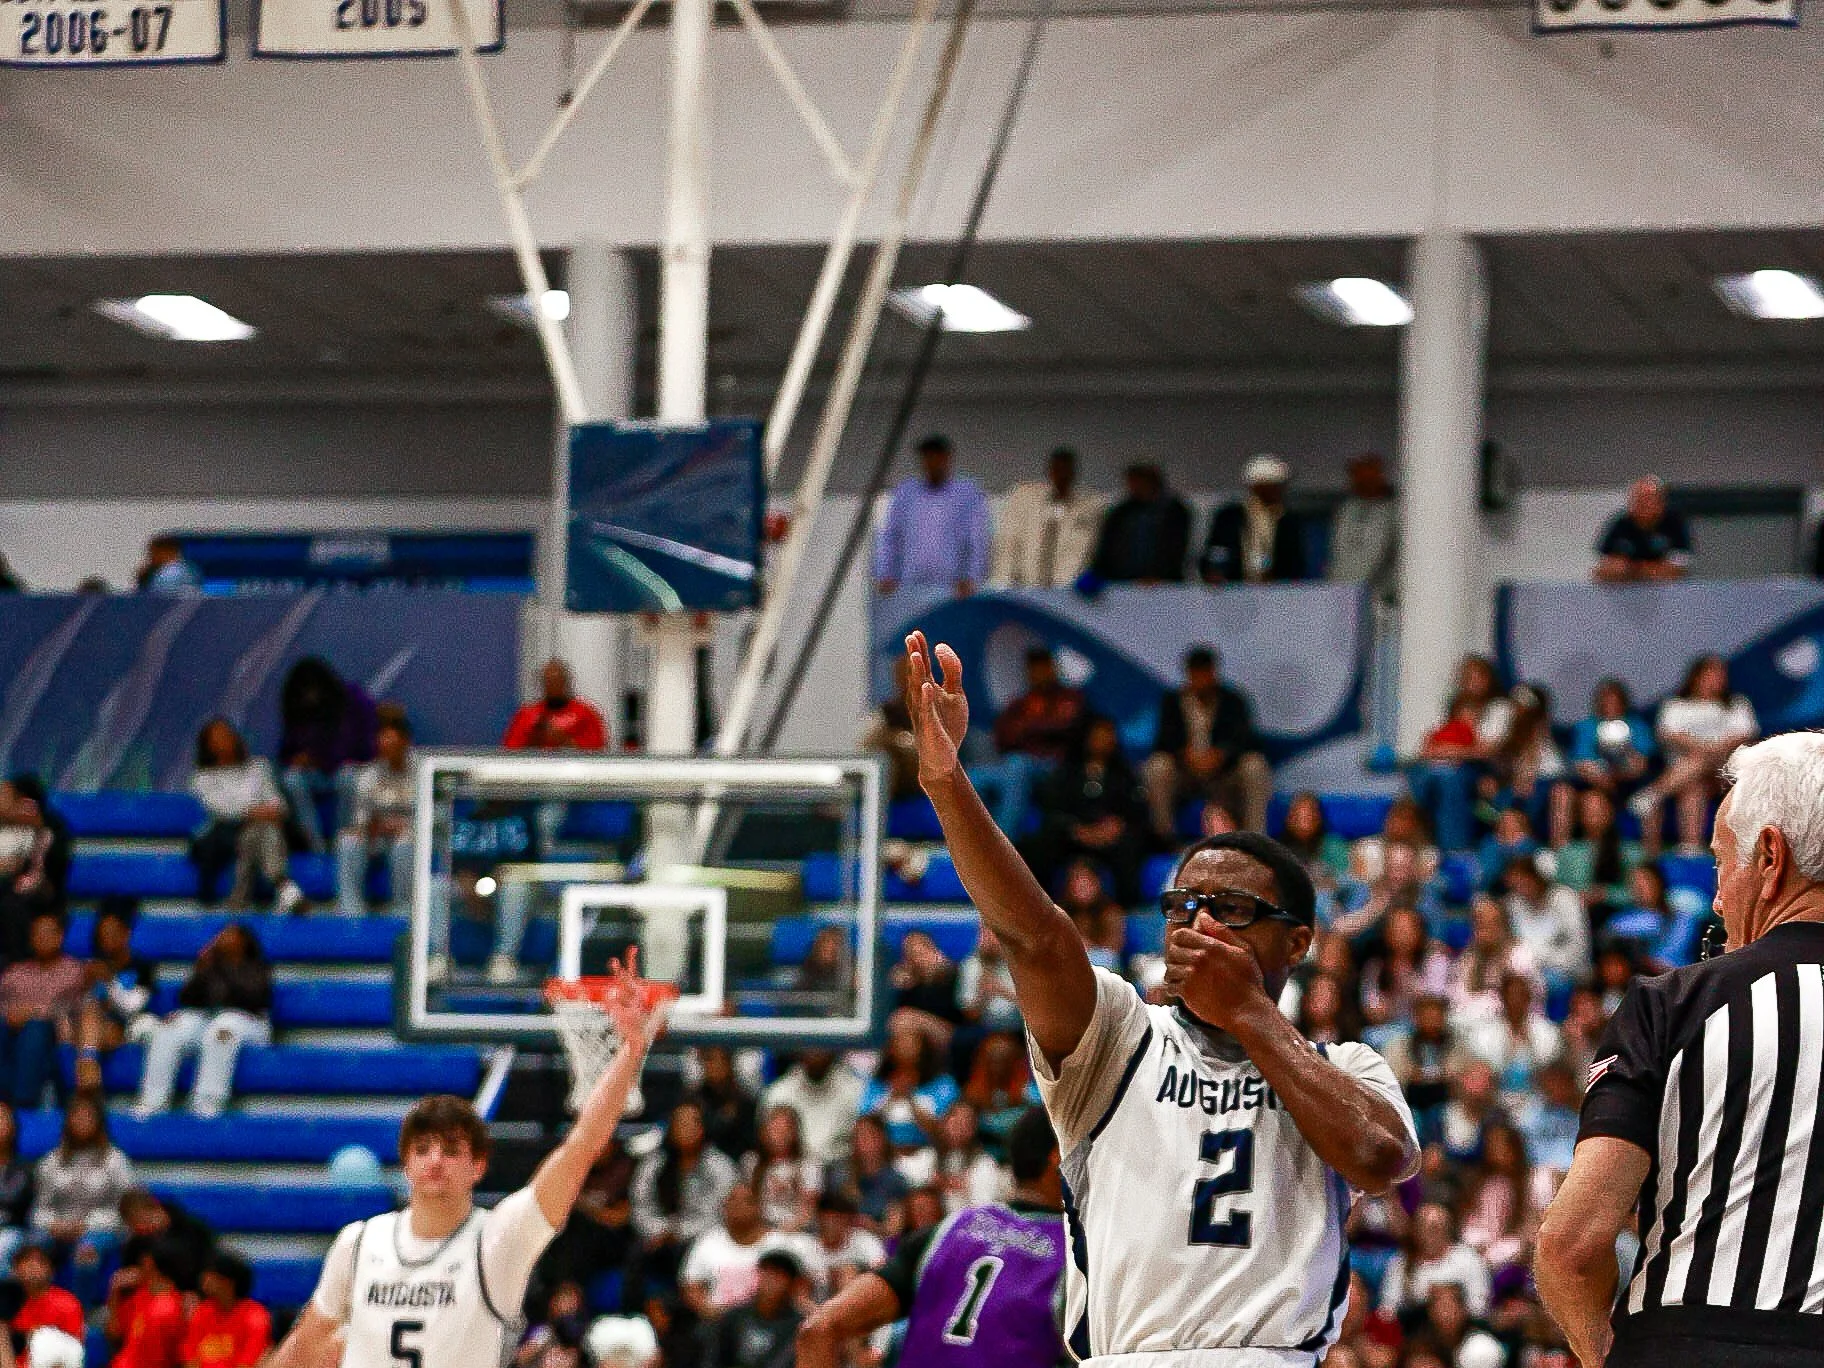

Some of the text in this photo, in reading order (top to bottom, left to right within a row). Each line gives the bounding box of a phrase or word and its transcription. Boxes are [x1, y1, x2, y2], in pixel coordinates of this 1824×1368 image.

[20, 6, 173, 54] 2006-07
[1187, 1128, 1255, 1248] 2
[367, 1279, 456, 1307] AUGUSTA
[941, 1256, 1004, 1346] 1
